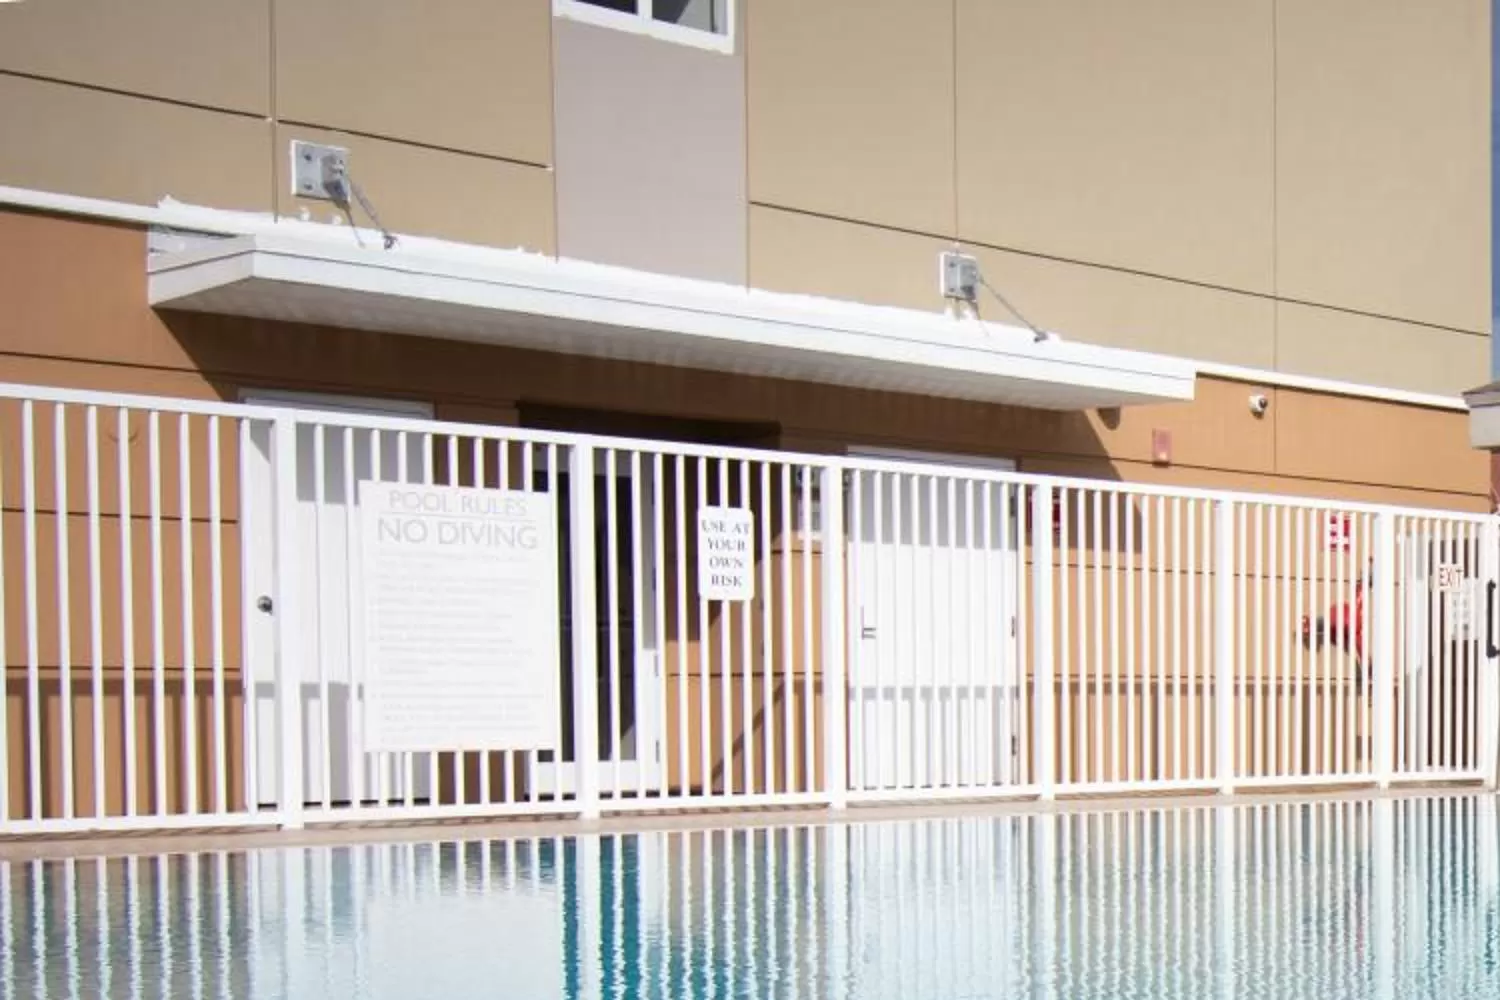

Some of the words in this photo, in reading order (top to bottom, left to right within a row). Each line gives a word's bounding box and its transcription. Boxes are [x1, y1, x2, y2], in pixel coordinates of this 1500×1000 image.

[388, 489, 452, 512] POOL
[461, 494, 528, 517] RULES
[377, 517, 429, 544] NO
[437, 521, 537, 550] DIVING
[701, 520, 727, 533] USE
[731, 522, 750, 535] AT
[708, 537, 747, 553] YOUR
[709, 556, 744, 569] OWN
[711, 574, 743, 588] RISK
[1439, 567, 1463, 588] EXIT
